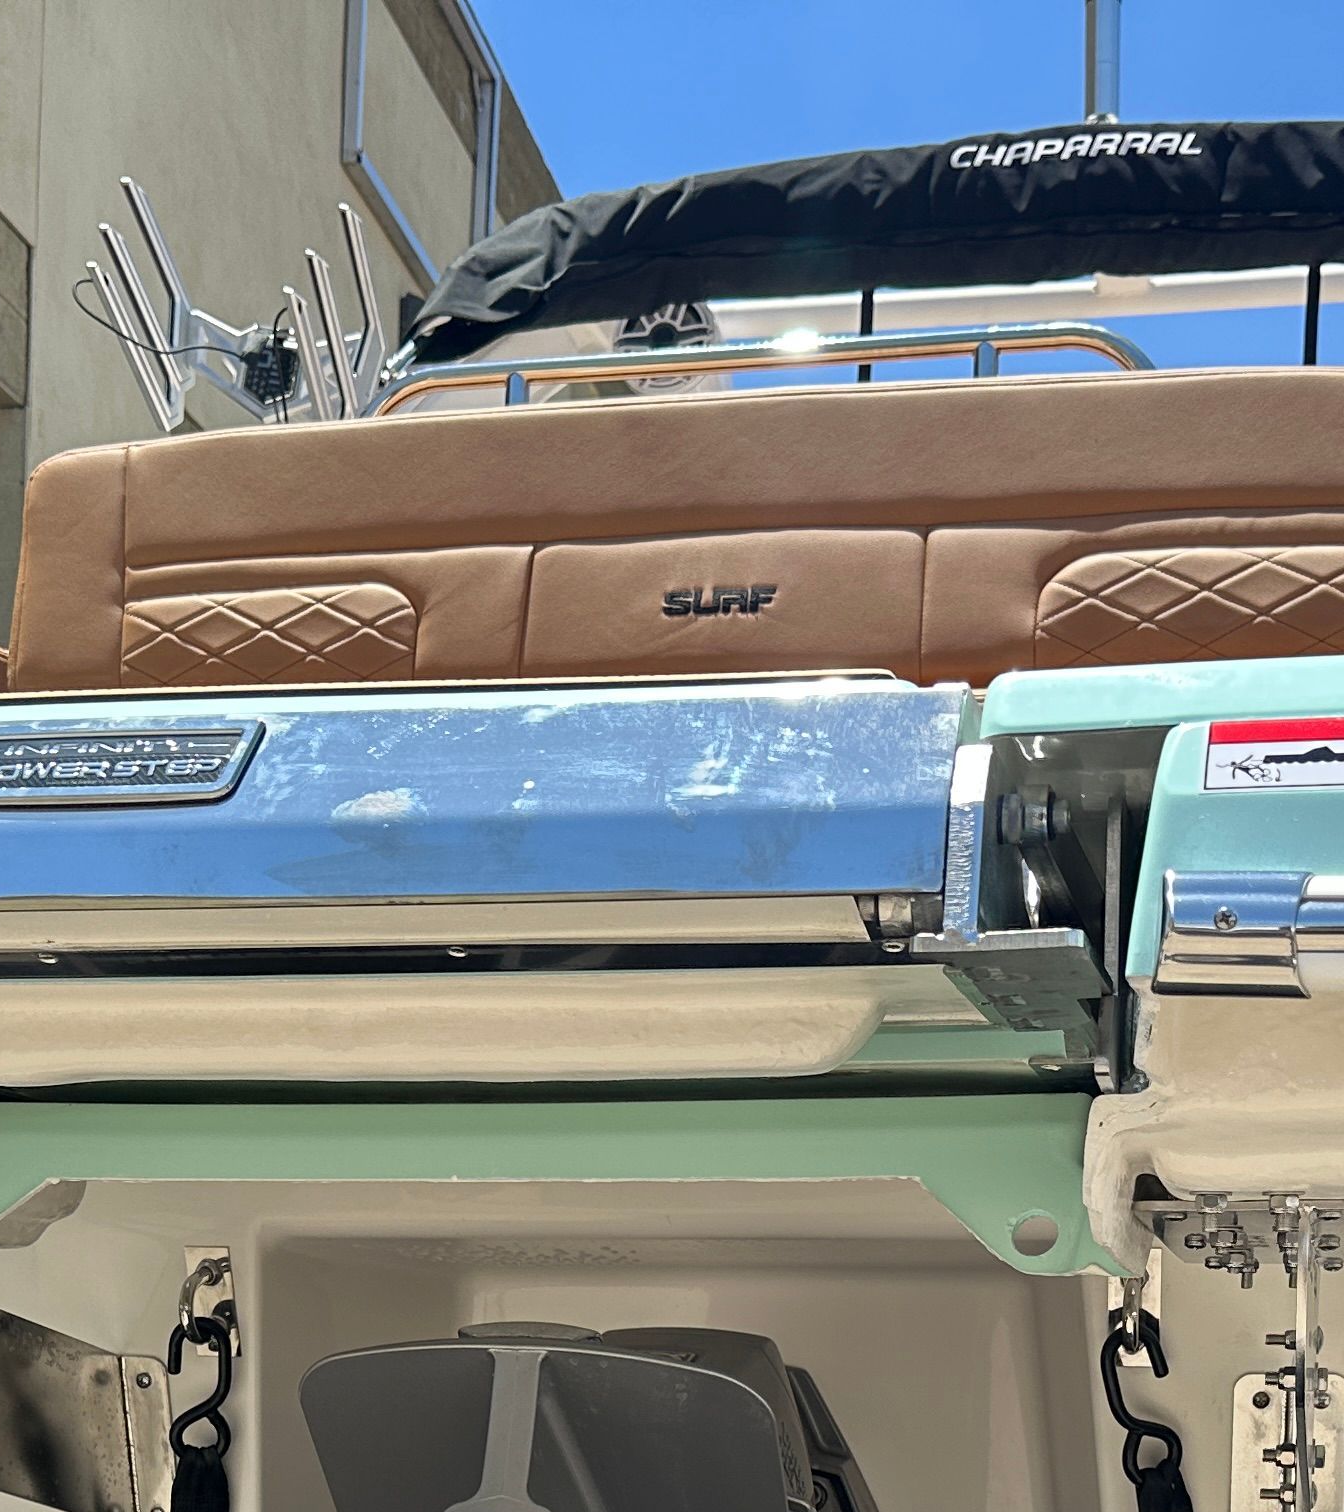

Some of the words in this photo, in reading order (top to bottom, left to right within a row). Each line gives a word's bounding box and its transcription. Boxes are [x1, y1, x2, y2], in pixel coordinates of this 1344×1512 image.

[949, 131, 1203, 169] CHAPARRAL
[662, 584, 778, 616] SURF
[4, 738, 180, 755] INFINITY
